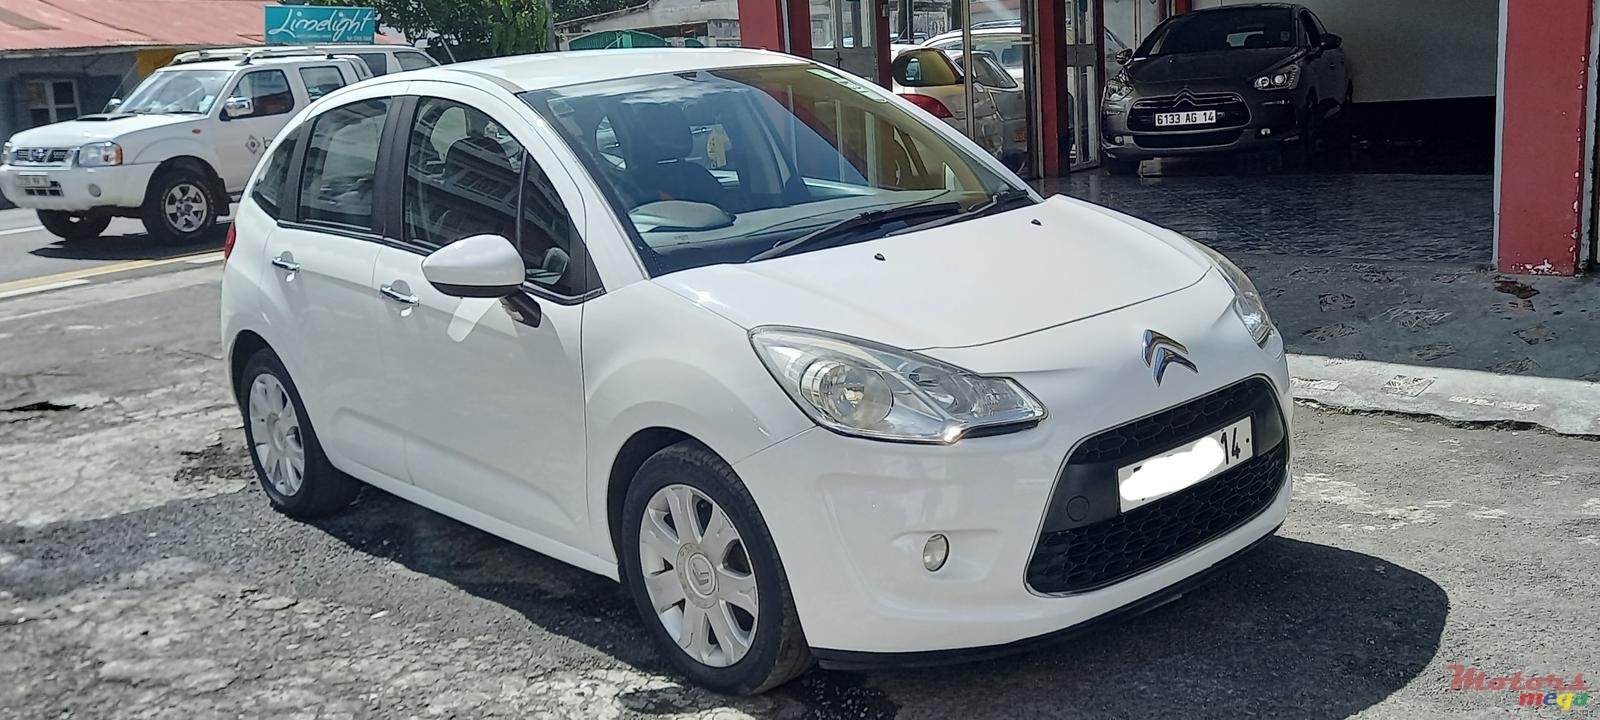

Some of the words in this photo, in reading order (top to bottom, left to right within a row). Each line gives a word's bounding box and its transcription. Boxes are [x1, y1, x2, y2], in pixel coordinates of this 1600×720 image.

[268, 8, 373, 41] Limelight
[1157, 114, 1181, 125] 6133
[1185, 112, 1197, 123] AG
[1202, 111, 1214, 122] 14
[1220, 427, 1241, 465] 14
